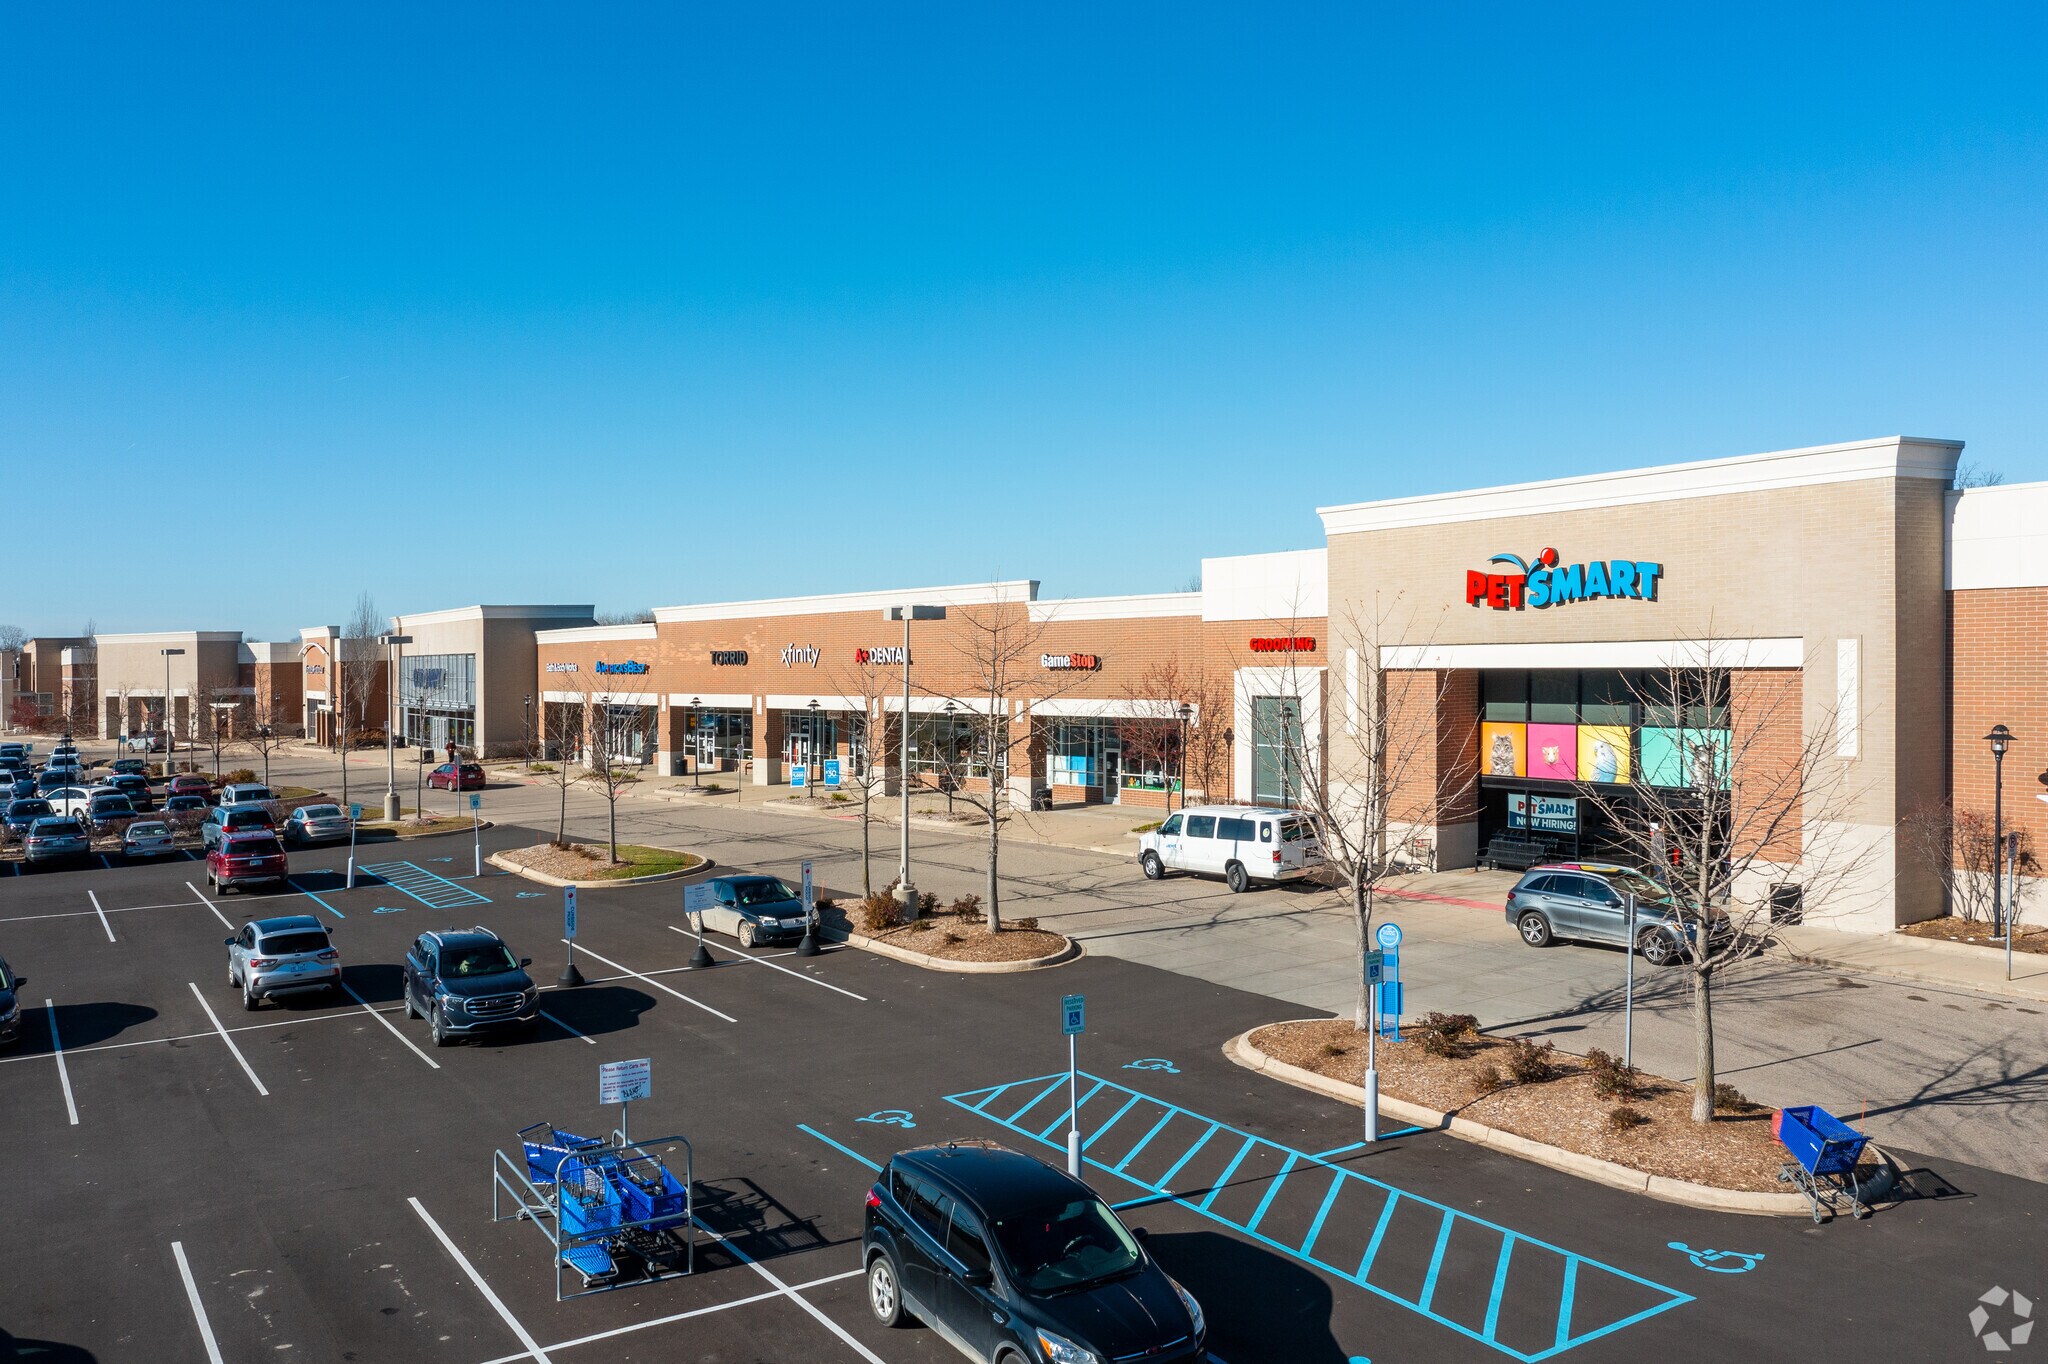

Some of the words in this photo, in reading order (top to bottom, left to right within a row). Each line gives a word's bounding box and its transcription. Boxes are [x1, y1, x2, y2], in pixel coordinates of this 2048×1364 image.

[1466, 557, 1660, 610] PETSMART
[1249, 636, 1316, 652] GROOMNG
[711, 651, 748, 665] TORRID
[781, 643, 820, 668] xfinity
[1041, 653, 1101, 671] GameStop
[1517, 800, 1575, 816] PTSMART
[1541, 818, 1577, 831] HIRING!
